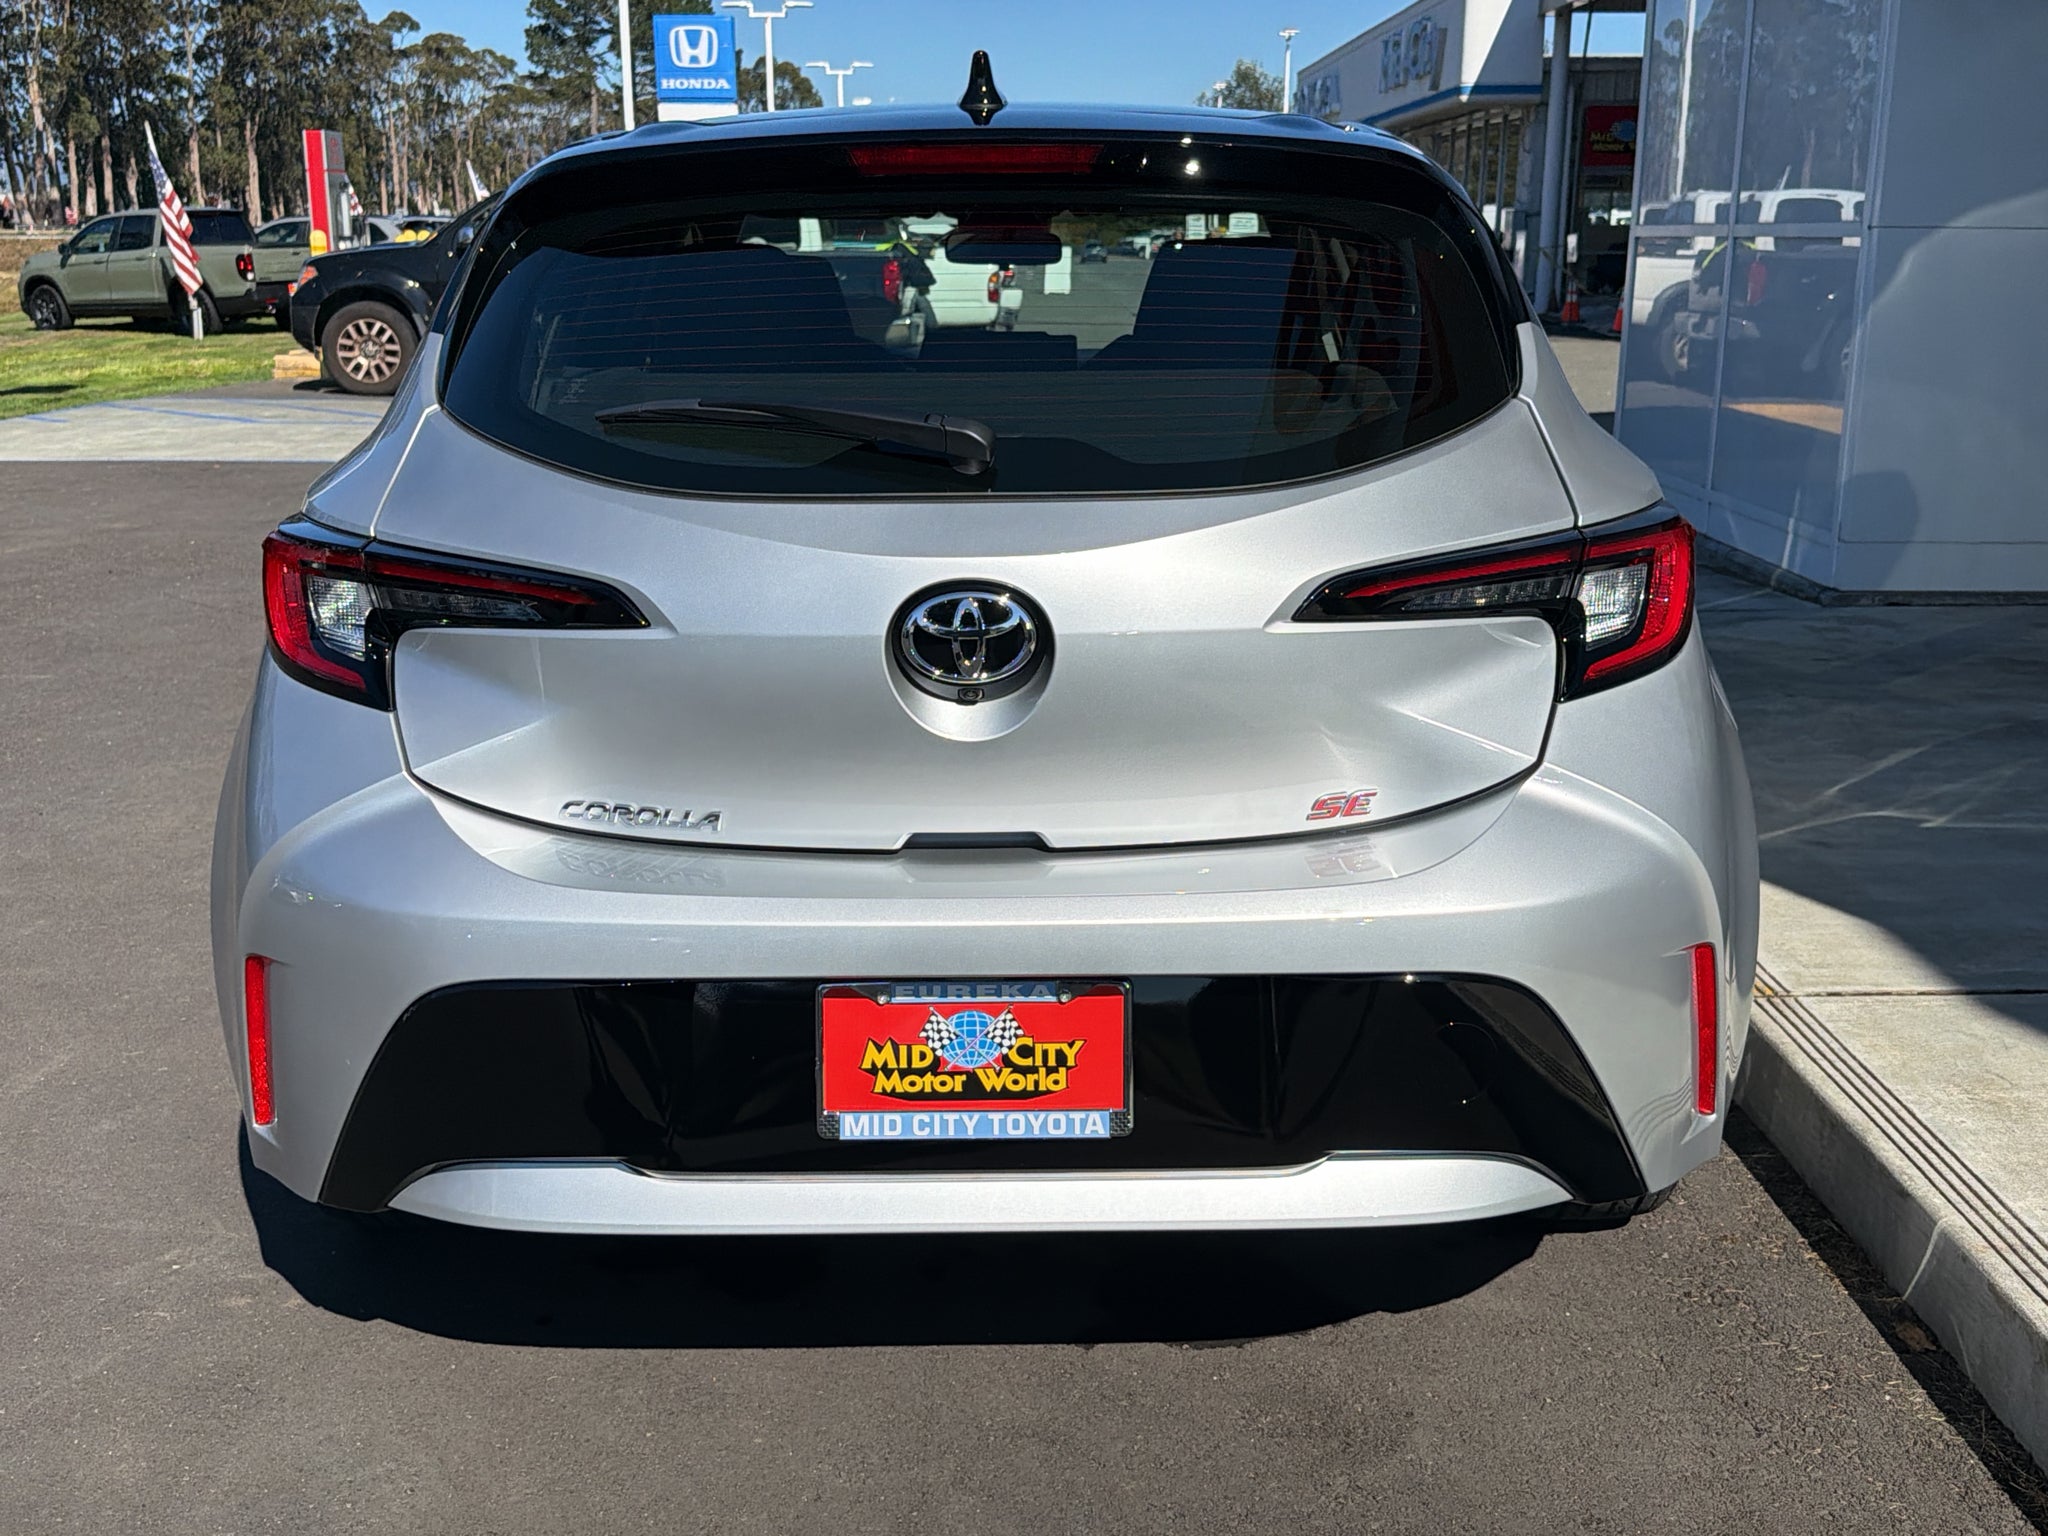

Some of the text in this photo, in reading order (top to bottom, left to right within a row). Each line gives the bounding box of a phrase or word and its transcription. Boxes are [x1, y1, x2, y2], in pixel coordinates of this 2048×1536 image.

[661, 78, 731, 90] HONDA
[559, 800, 723, 833] COROLLA
[1306, 788, 1378, 821] SE
[895, 984, 1052, 999] EUREKA
[860, 1036, 1086, 1069] MID CITY
[873, 1067, 1067, 1094] Motor World
[844, 1112, 1106, 1137] MID CITY TOYOTA
